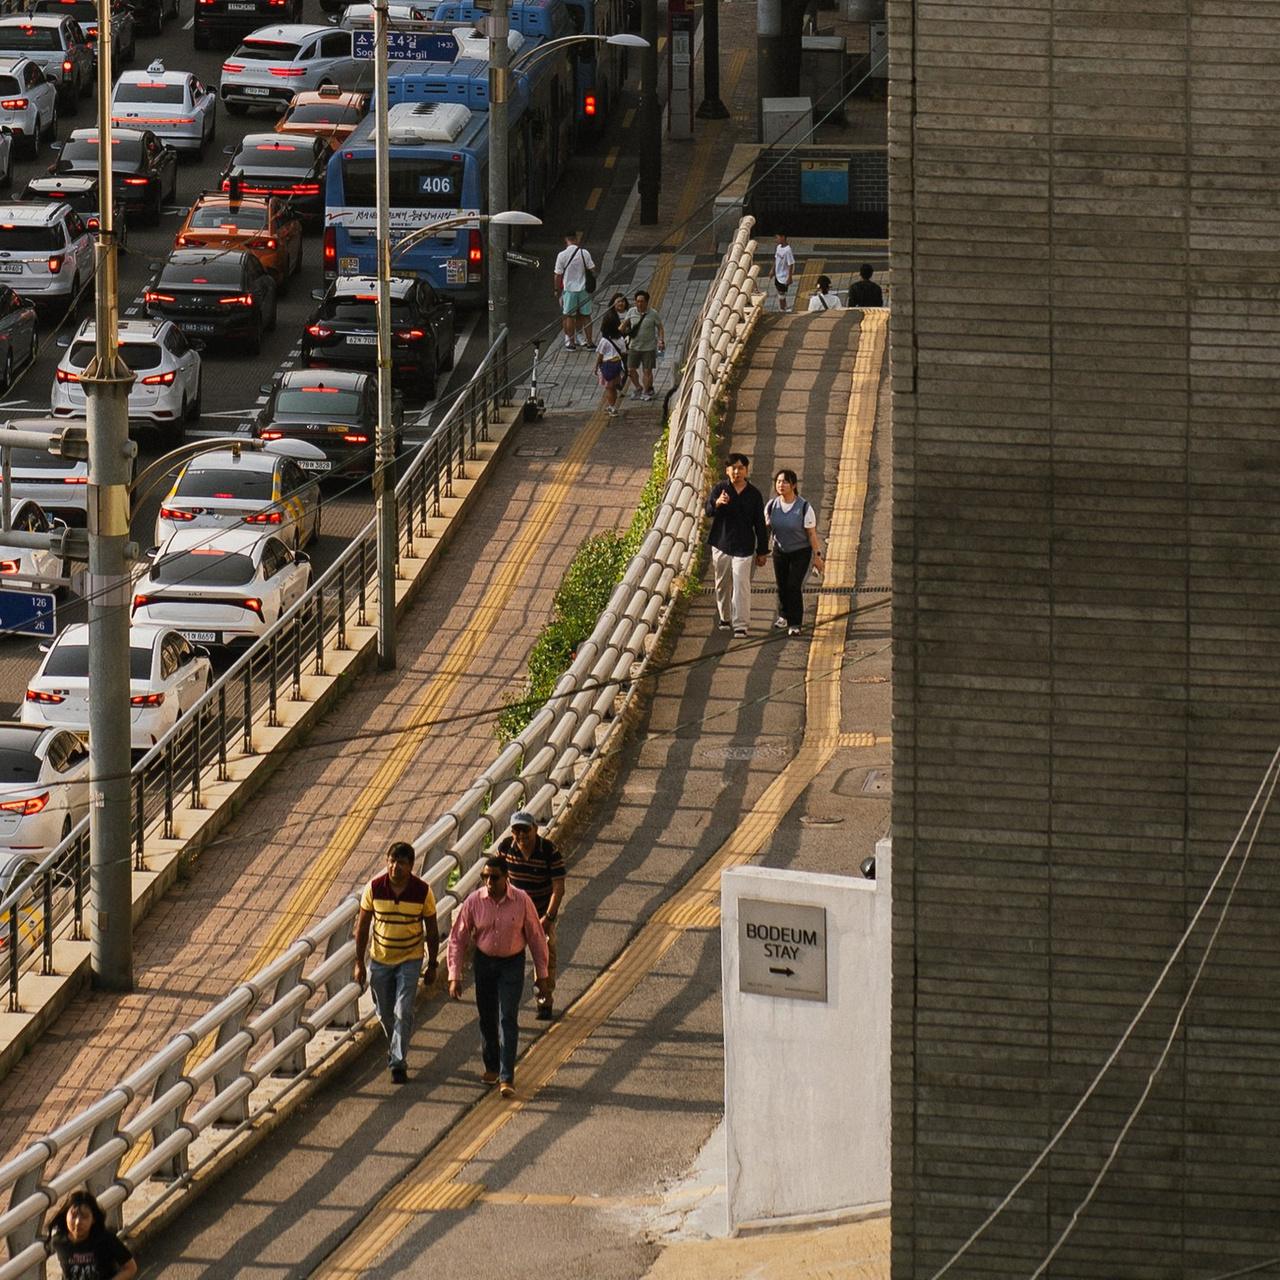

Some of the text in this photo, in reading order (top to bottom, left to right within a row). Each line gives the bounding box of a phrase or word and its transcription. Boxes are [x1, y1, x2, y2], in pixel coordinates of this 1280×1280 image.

[406, 52, 428, 60] 4-gil
[422, 177, 450, 193] 406
[31, 597, 47, 607] 126
[34, 621, 45, 631] 26
[746, 923, 817, 946] BODEUM
[764, 943, 800, 960] STAY
